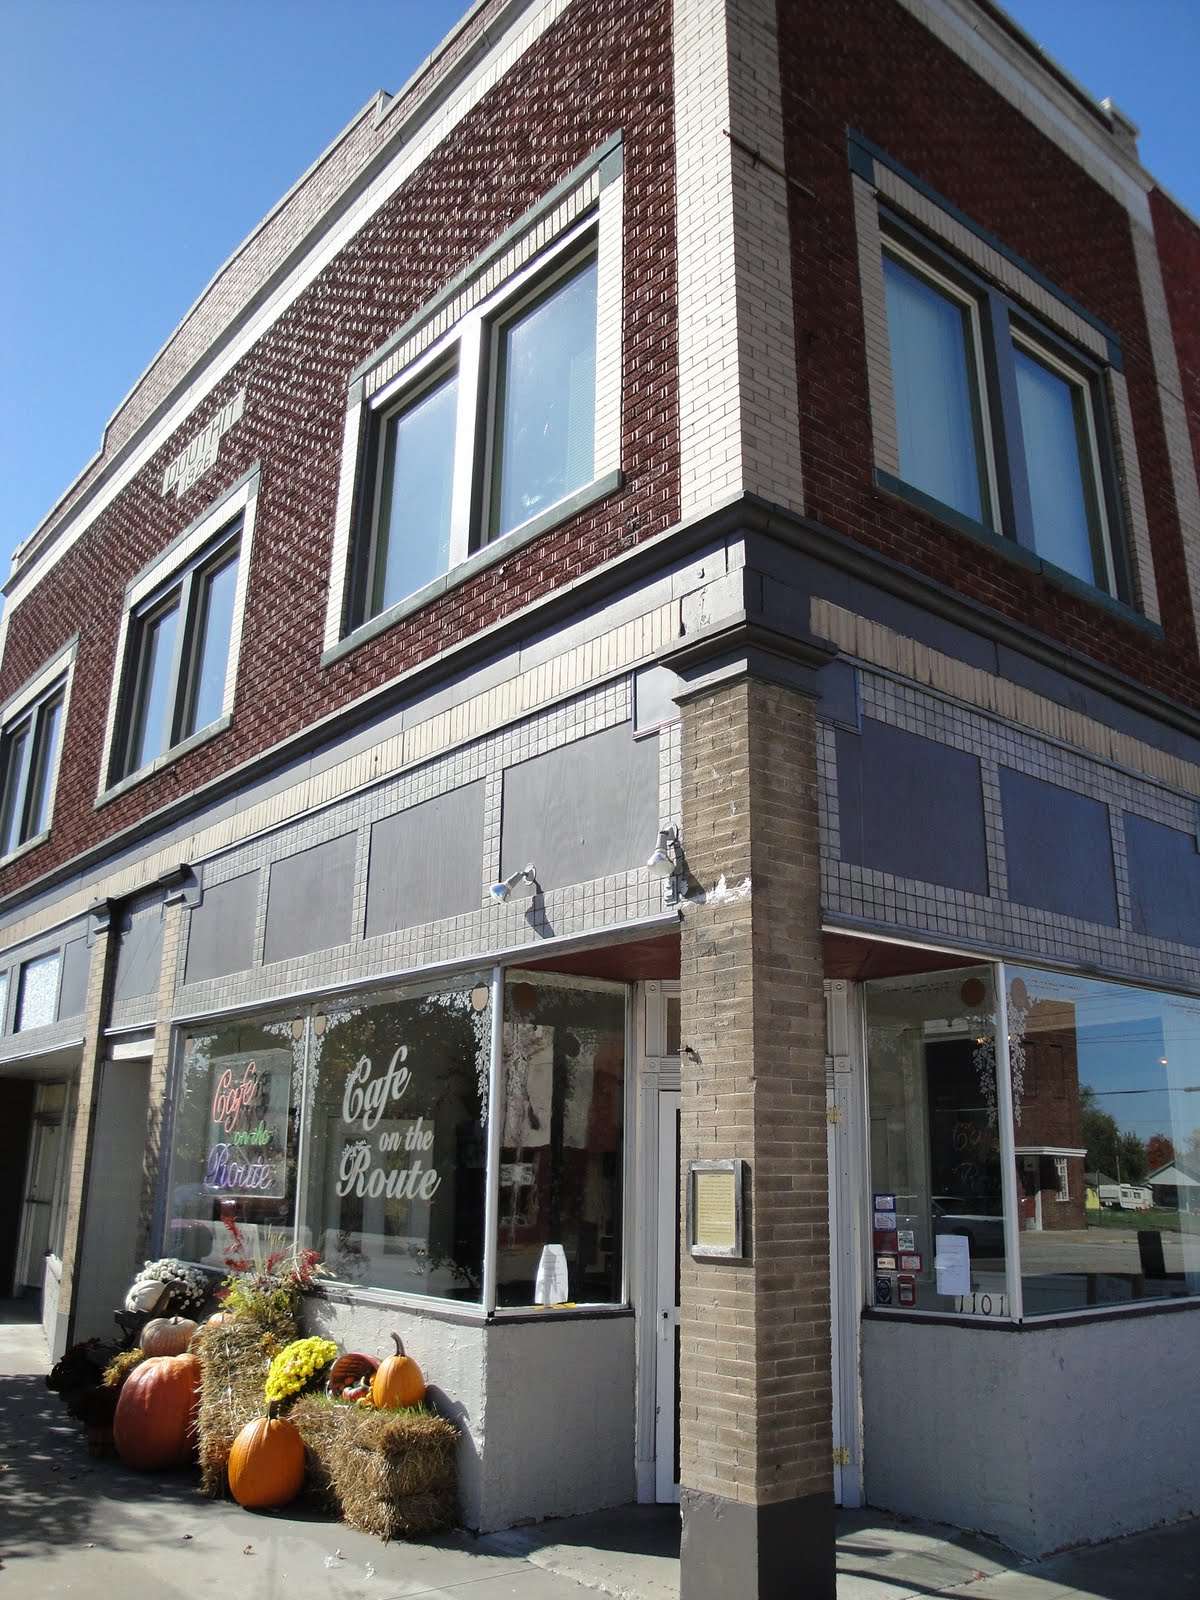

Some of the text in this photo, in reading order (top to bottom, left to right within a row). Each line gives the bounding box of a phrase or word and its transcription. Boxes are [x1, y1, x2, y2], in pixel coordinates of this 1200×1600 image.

[167, 395, 240, 489] DOUTHIT
[183, 449, 213, 492] 1926
[212, 1061, 257, 1133] Cafe
[342, 1045, 412, 1131] Cafe
[379, 1116, 435, 1153] on the
[204, 1142, 274, 1190] Route
[336, 1143, 442, 1201] Route
[959, 1292, 1004, 1317] 1101
